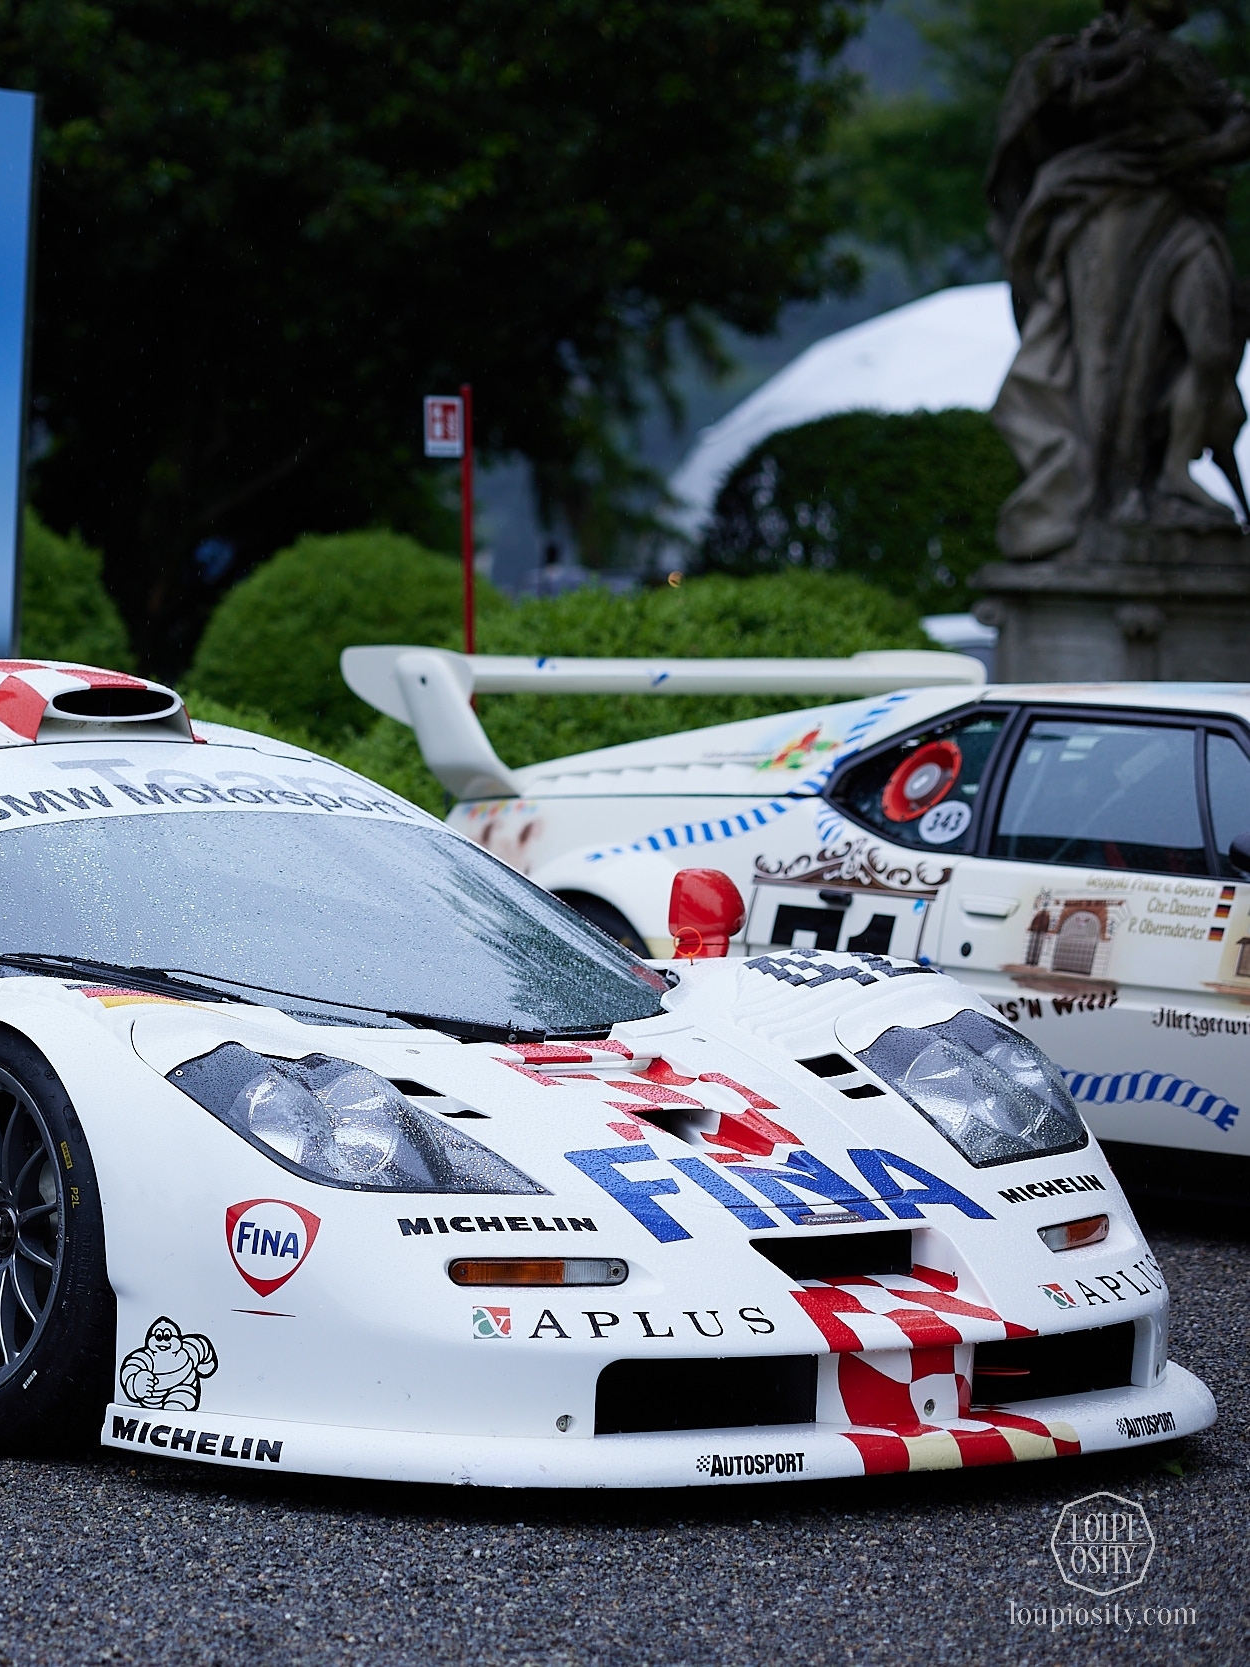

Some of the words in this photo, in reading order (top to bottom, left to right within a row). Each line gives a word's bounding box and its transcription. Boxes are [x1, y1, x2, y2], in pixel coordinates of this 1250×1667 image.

[113, 782, 414, 819] Motorsport
[70, 1186, 80, 1209] P2L
[563, 1142, 998, 1244] FINA
[997, 1174, 1107, 1204] MICHELIN
[236, 1221, 299, 1259] FINA
[396, 1216, 599, 1237] MICHELIN
[528, 1306, 776, 1340] APLUS
[111, 1415, 284, 1464] MICHELIN
[1123, 1411, 1176, 1439] AUTOSPORT
[710, 1452, 805, 1477] AUTOSPORT
